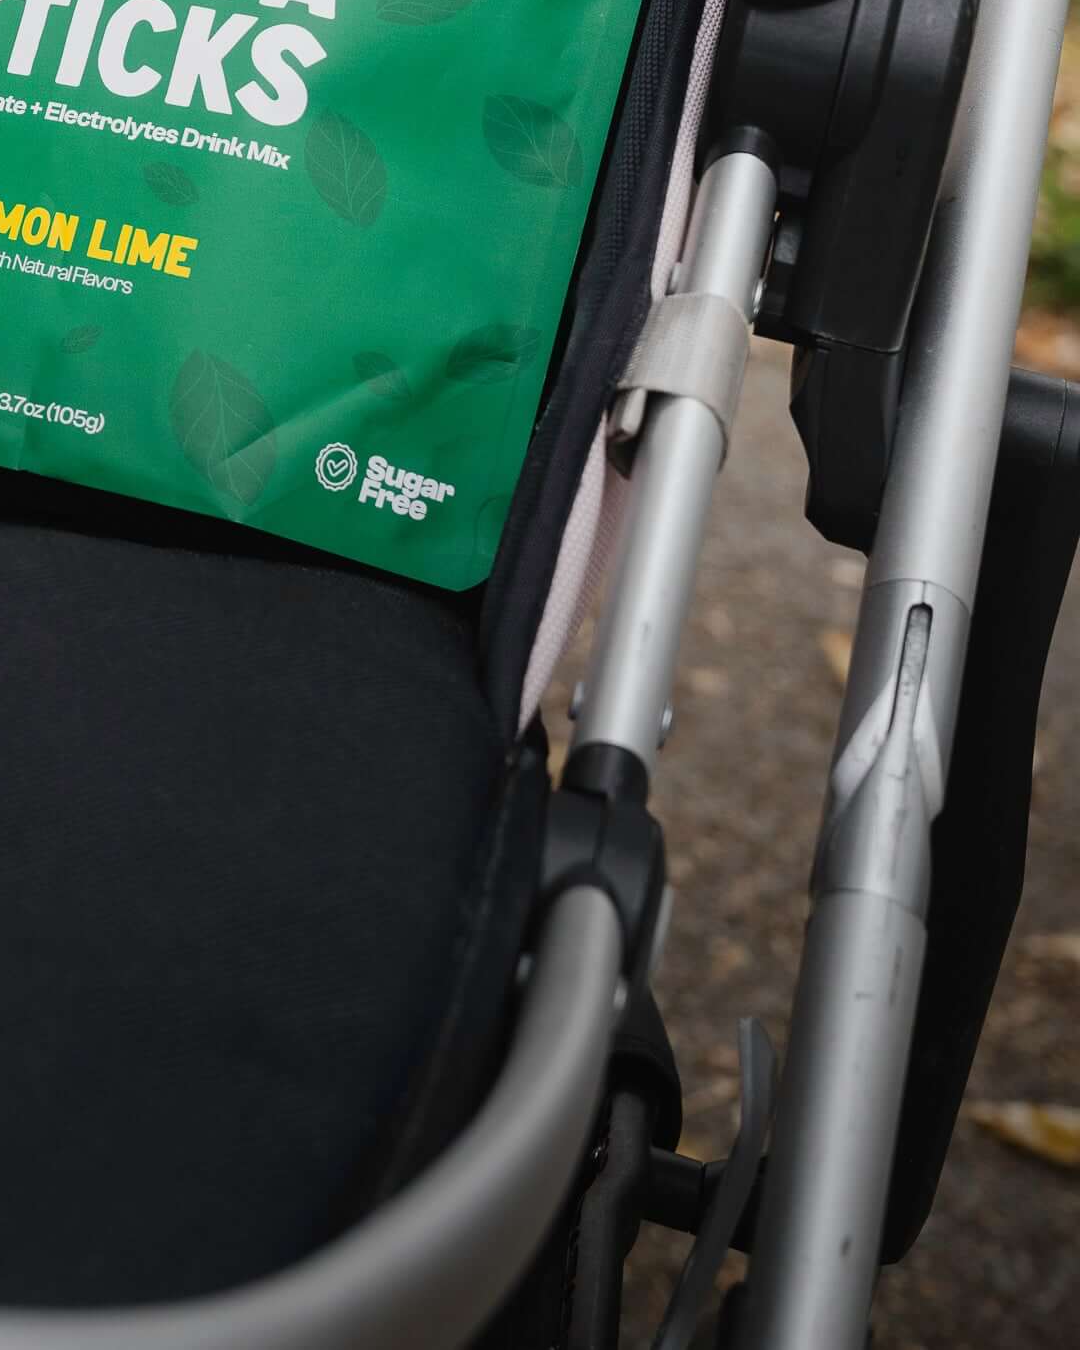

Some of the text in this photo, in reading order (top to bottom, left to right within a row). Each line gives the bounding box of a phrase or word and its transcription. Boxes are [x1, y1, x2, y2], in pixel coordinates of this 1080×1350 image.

[30, 101, 43, 116] +
[44, 102, 179, 145] Electrolytes
[180, 127, 245, 158] Drink
[246, 140, 292, 170] Mix
[86, 218, 199, 278] LIME
[11, 254, 73, 282] Natural
[72, 266, 134, 295] Flavors
[46, 402, 105, 435] (105g)
[358, 477, 427, 520] Free
[366, 455, 456, 502] Sugar
